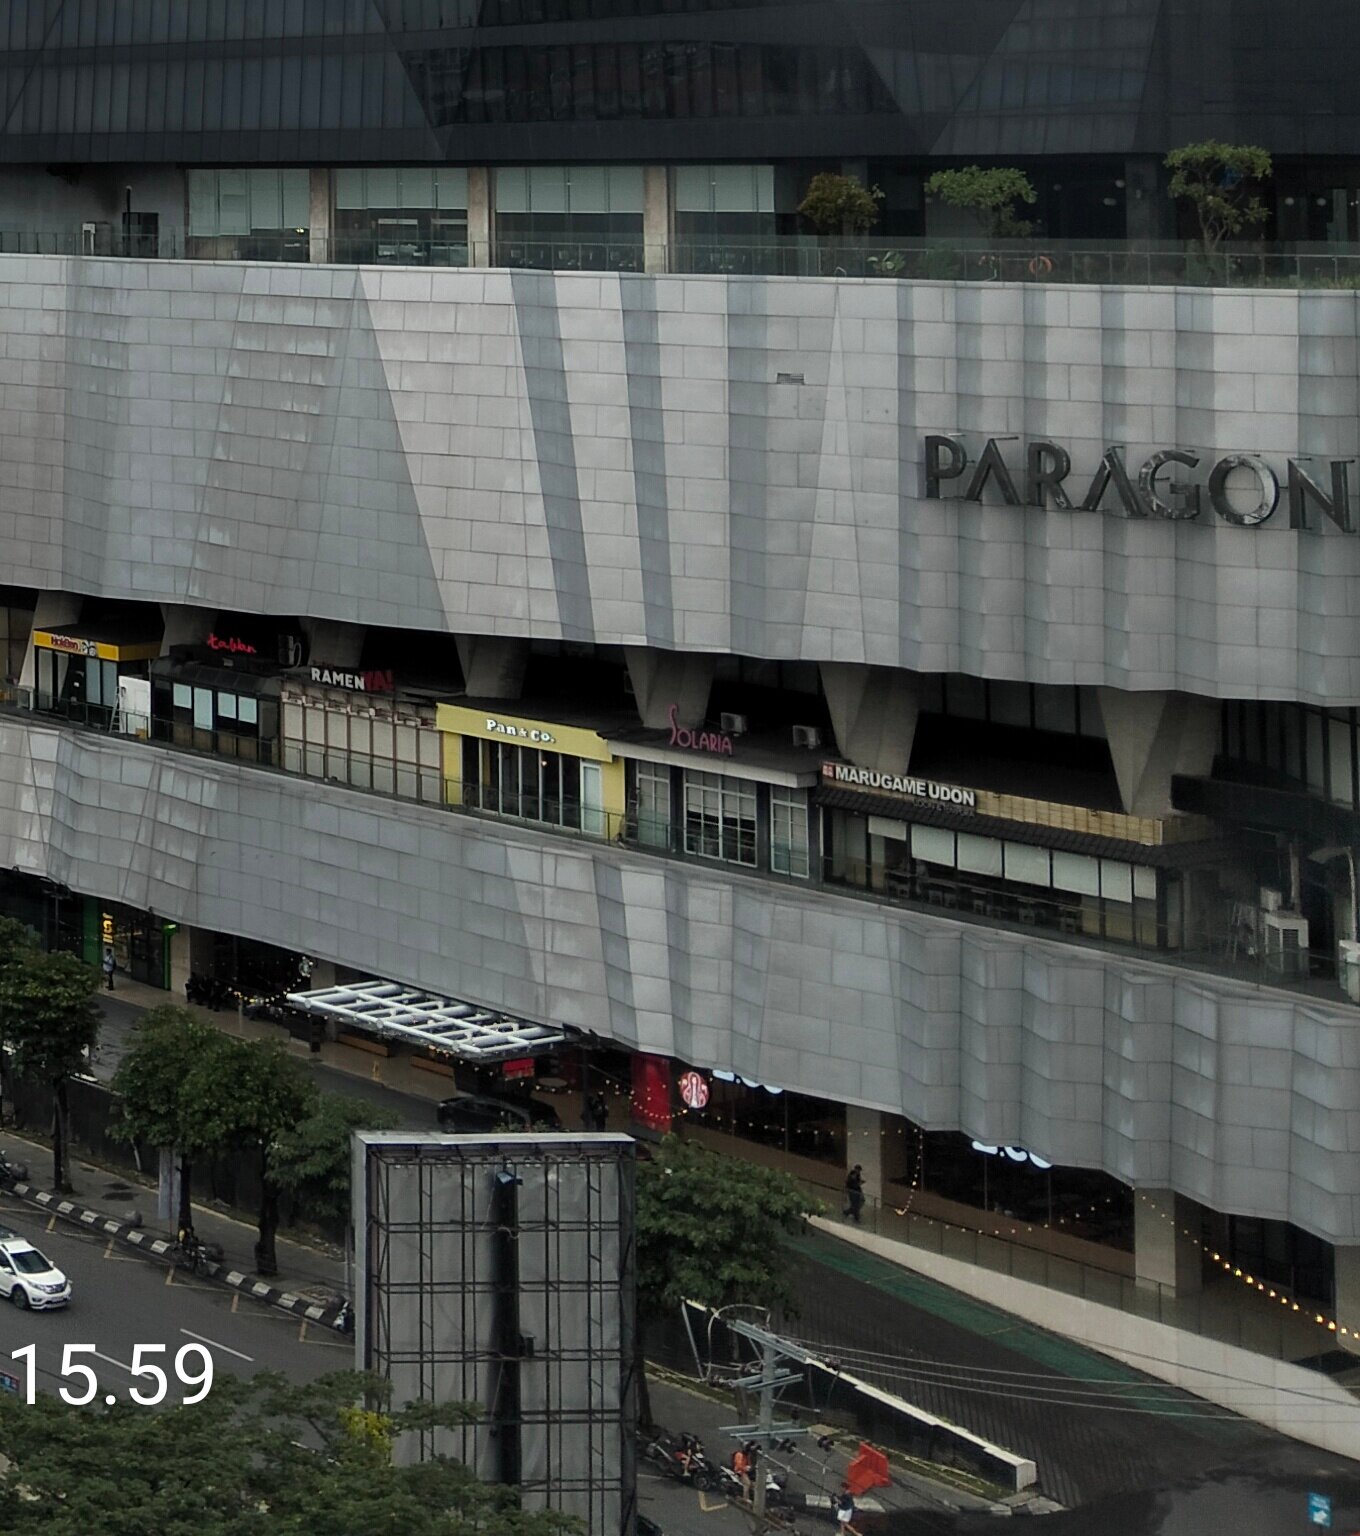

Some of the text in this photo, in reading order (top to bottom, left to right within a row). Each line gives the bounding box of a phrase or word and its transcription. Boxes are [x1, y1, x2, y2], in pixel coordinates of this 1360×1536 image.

[924, 432, 1356, 533] PARAGON
[311, 667, 365, 691] RAMEN
[486, 719, 517, 736] Pan
[530, 729, 557, 743] Co.
[835, 766, 976, 807] MARUGAME UDON
